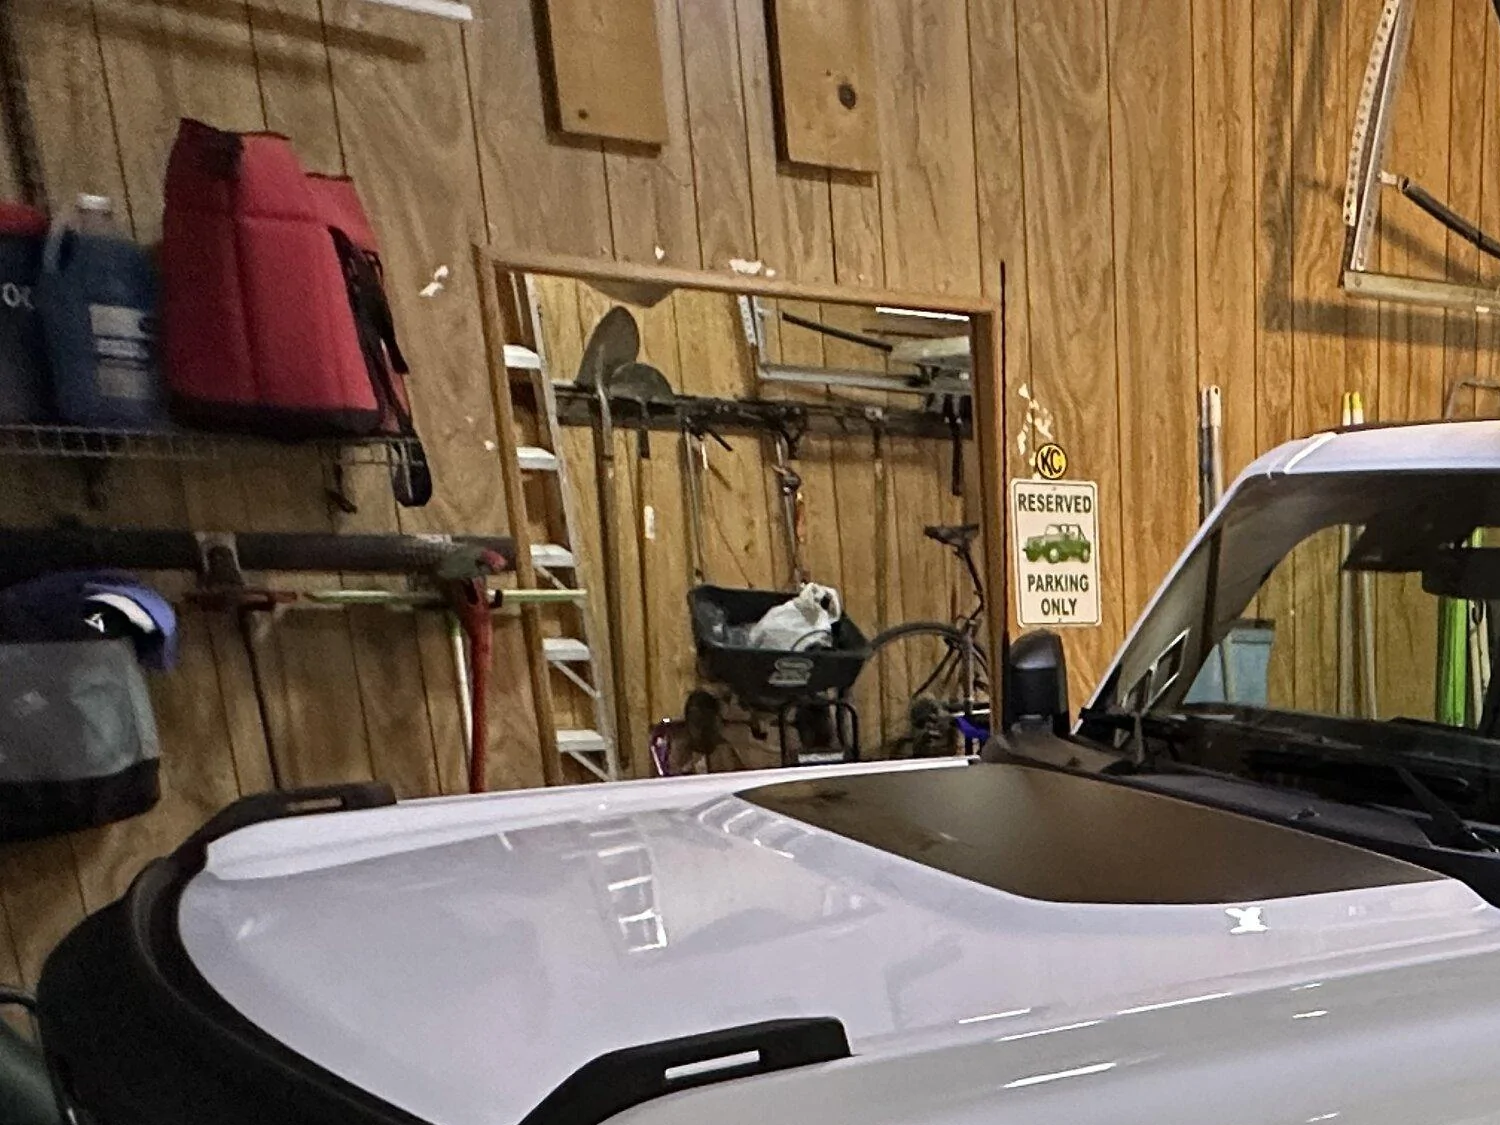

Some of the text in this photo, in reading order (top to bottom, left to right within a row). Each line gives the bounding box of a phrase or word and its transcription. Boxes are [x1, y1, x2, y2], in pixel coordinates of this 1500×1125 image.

[1040, 448, 1063, 476] KC
[1018, 493, 1092, 514] RESERVED
[1027, 574, 1090, 593] PARKING
[1040, 598, 1078, 617] ONLY
